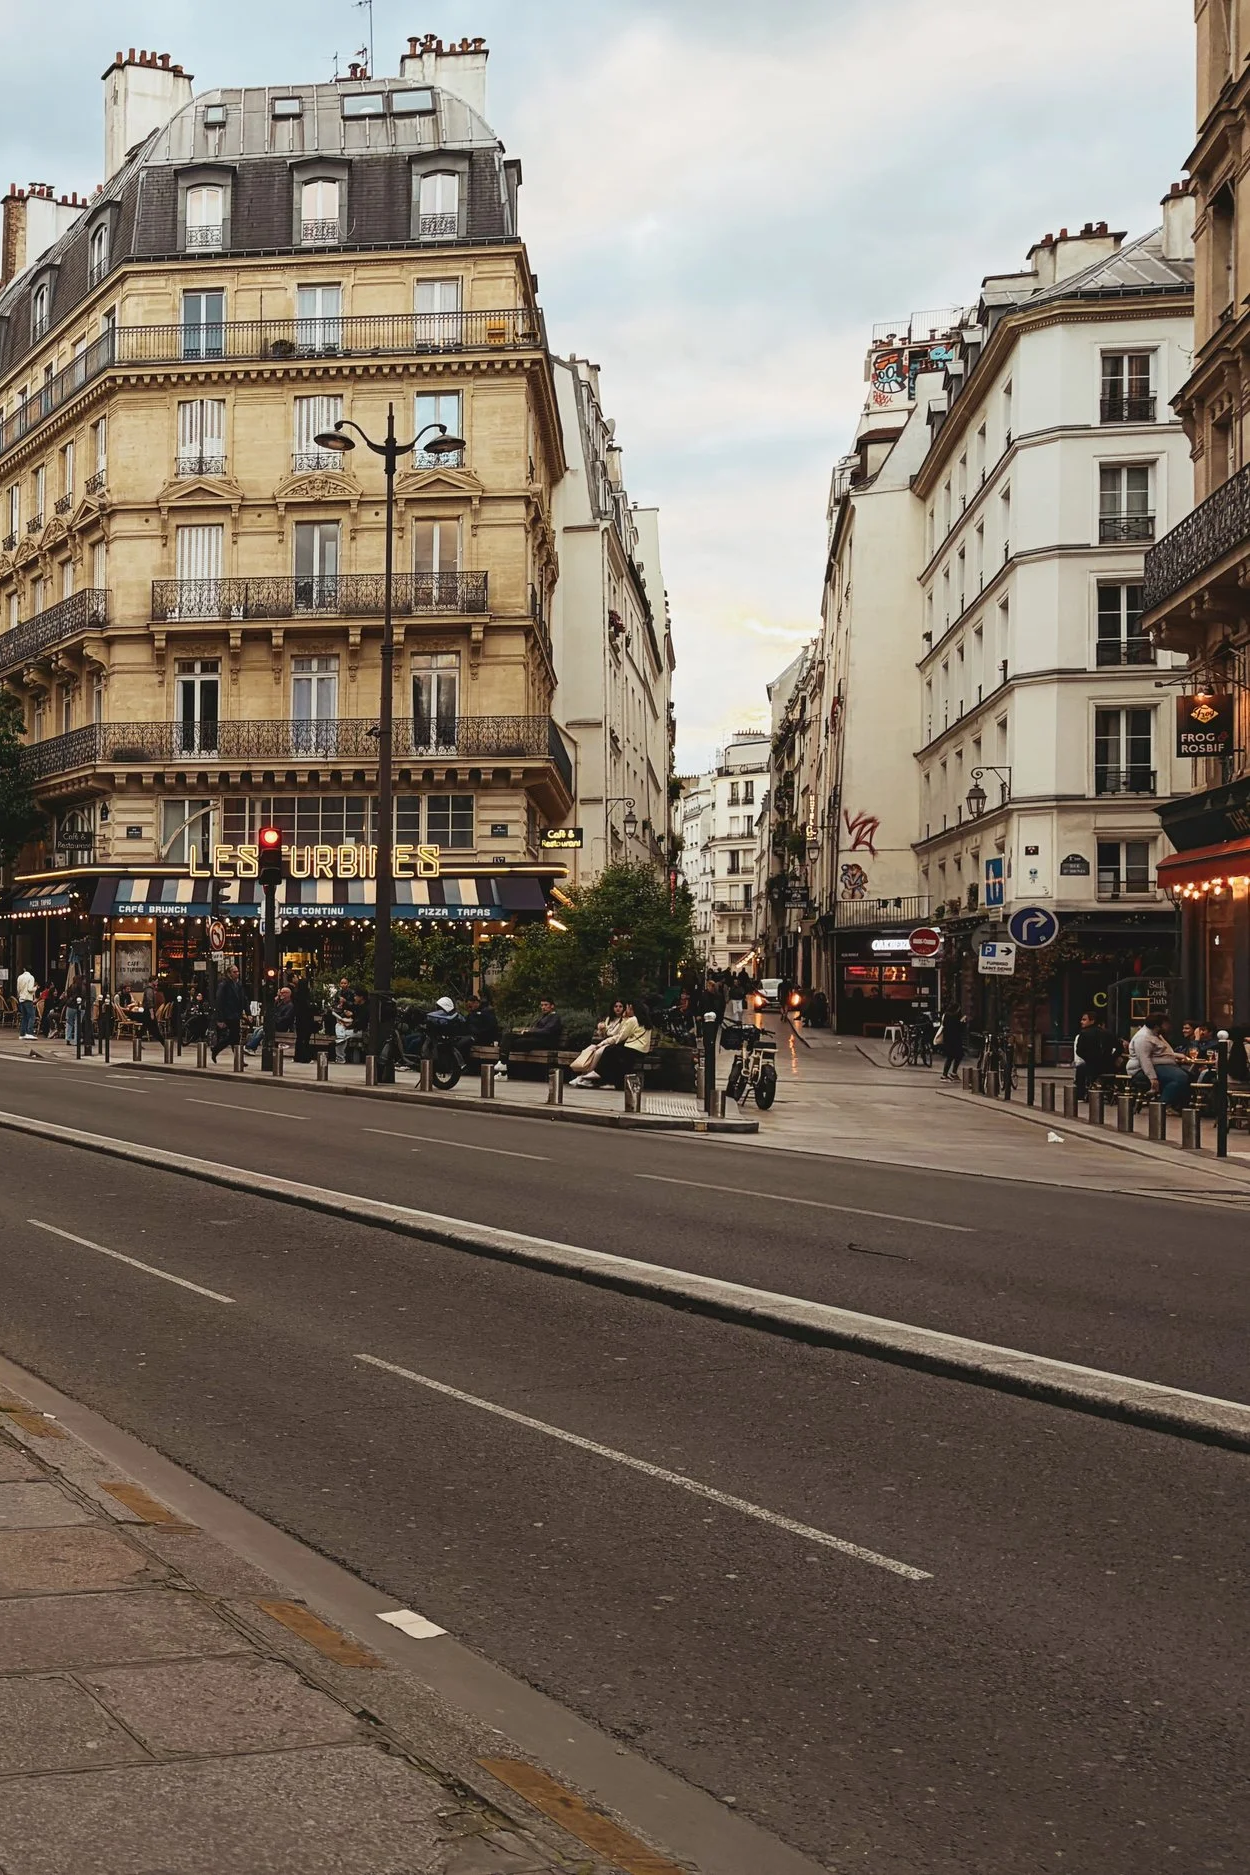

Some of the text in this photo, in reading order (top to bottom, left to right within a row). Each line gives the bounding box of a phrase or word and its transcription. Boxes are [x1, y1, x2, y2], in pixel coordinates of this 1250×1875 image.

[1181, 732, 1215, 743] FROG
[1181, 743, 1225, 753] ROSBIF
[547, 829, 575, 839] Café &
[541, 840, 581, 848] Restaurant
[189, 844, 440, 878] LES URBIES
[118, 904, 187, 914] CAFÉ BRUNCH
[301, 906, 344, 915] CONTINU
[418, 907, 491, 917] PIZZA TAPAS
[984, 946, 993, 955] P
[1147, 989, 1167, 997] Love
